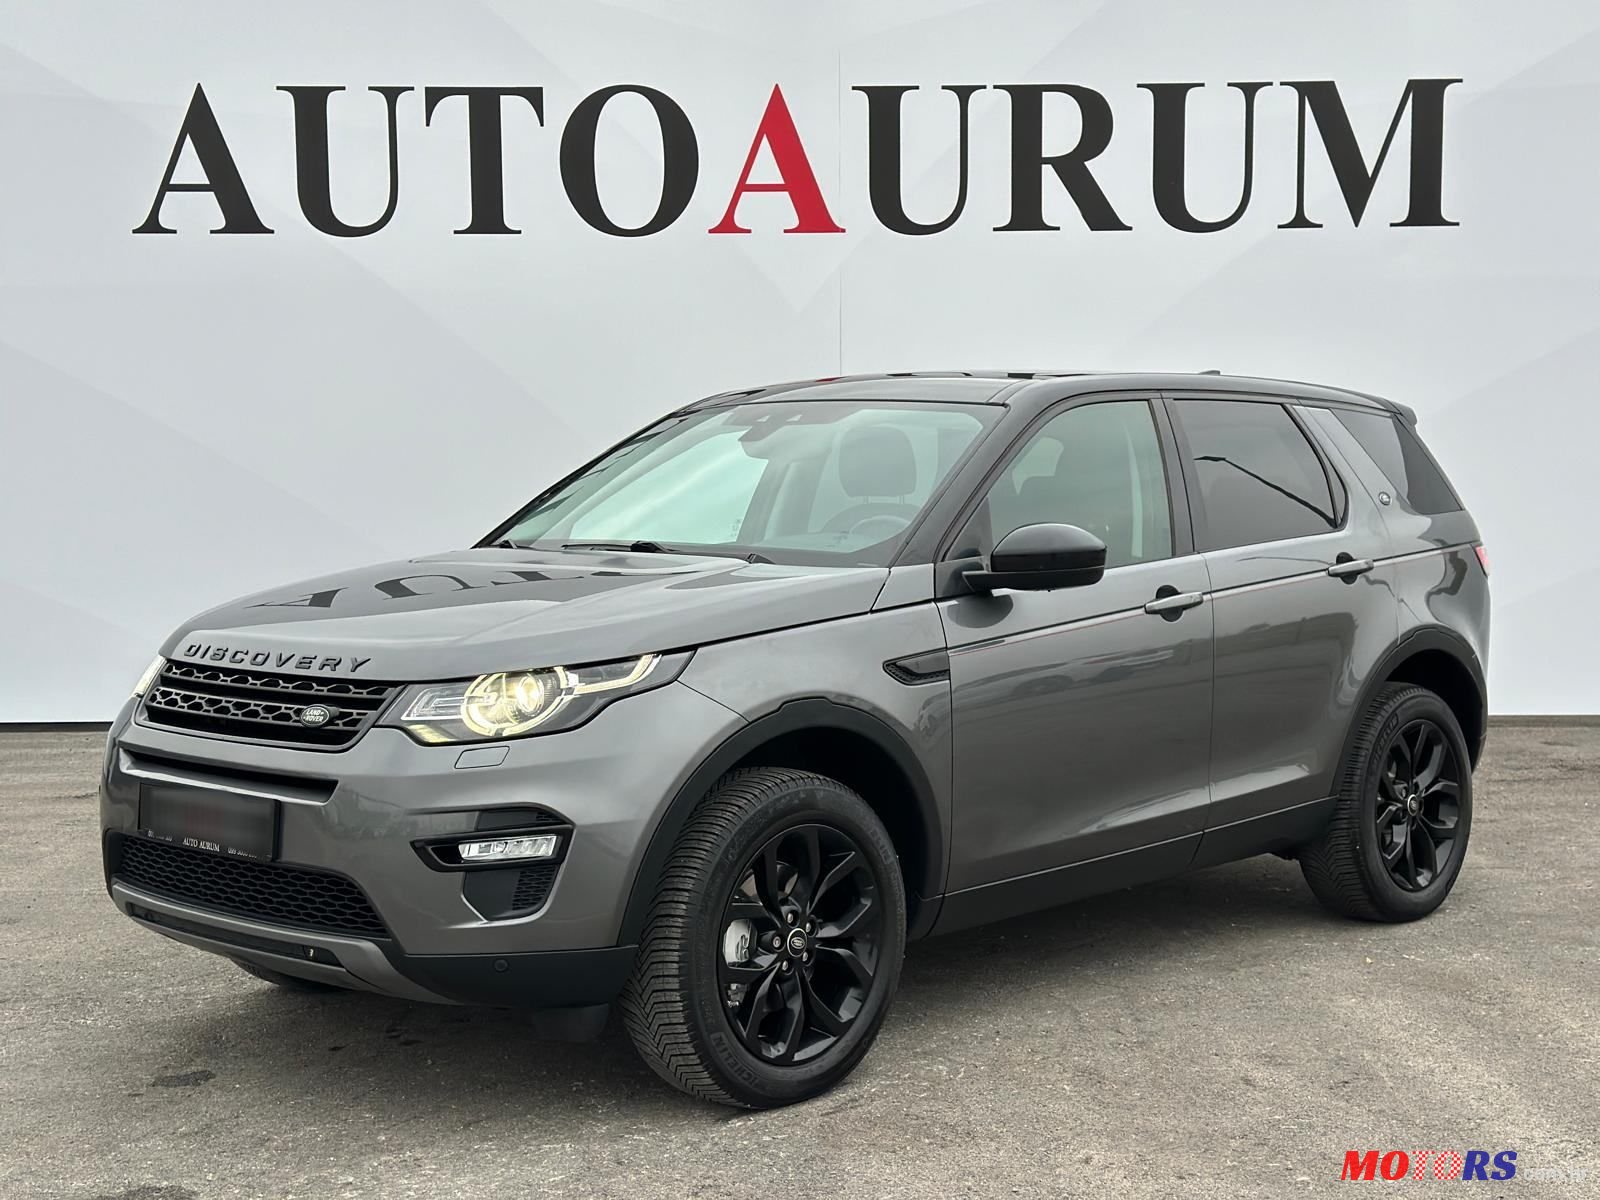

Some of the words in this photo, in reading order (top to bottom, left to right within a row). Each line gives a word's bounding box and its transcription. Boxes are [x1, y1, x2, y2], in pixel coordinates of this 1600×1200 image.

[132, 78, 1463, 237] AUTOAURUM
[184, 643, 371, 673] DISCOVERY
[183, 837, 198, 848] AUTO
[199, 840, 220, 852] AURUM
